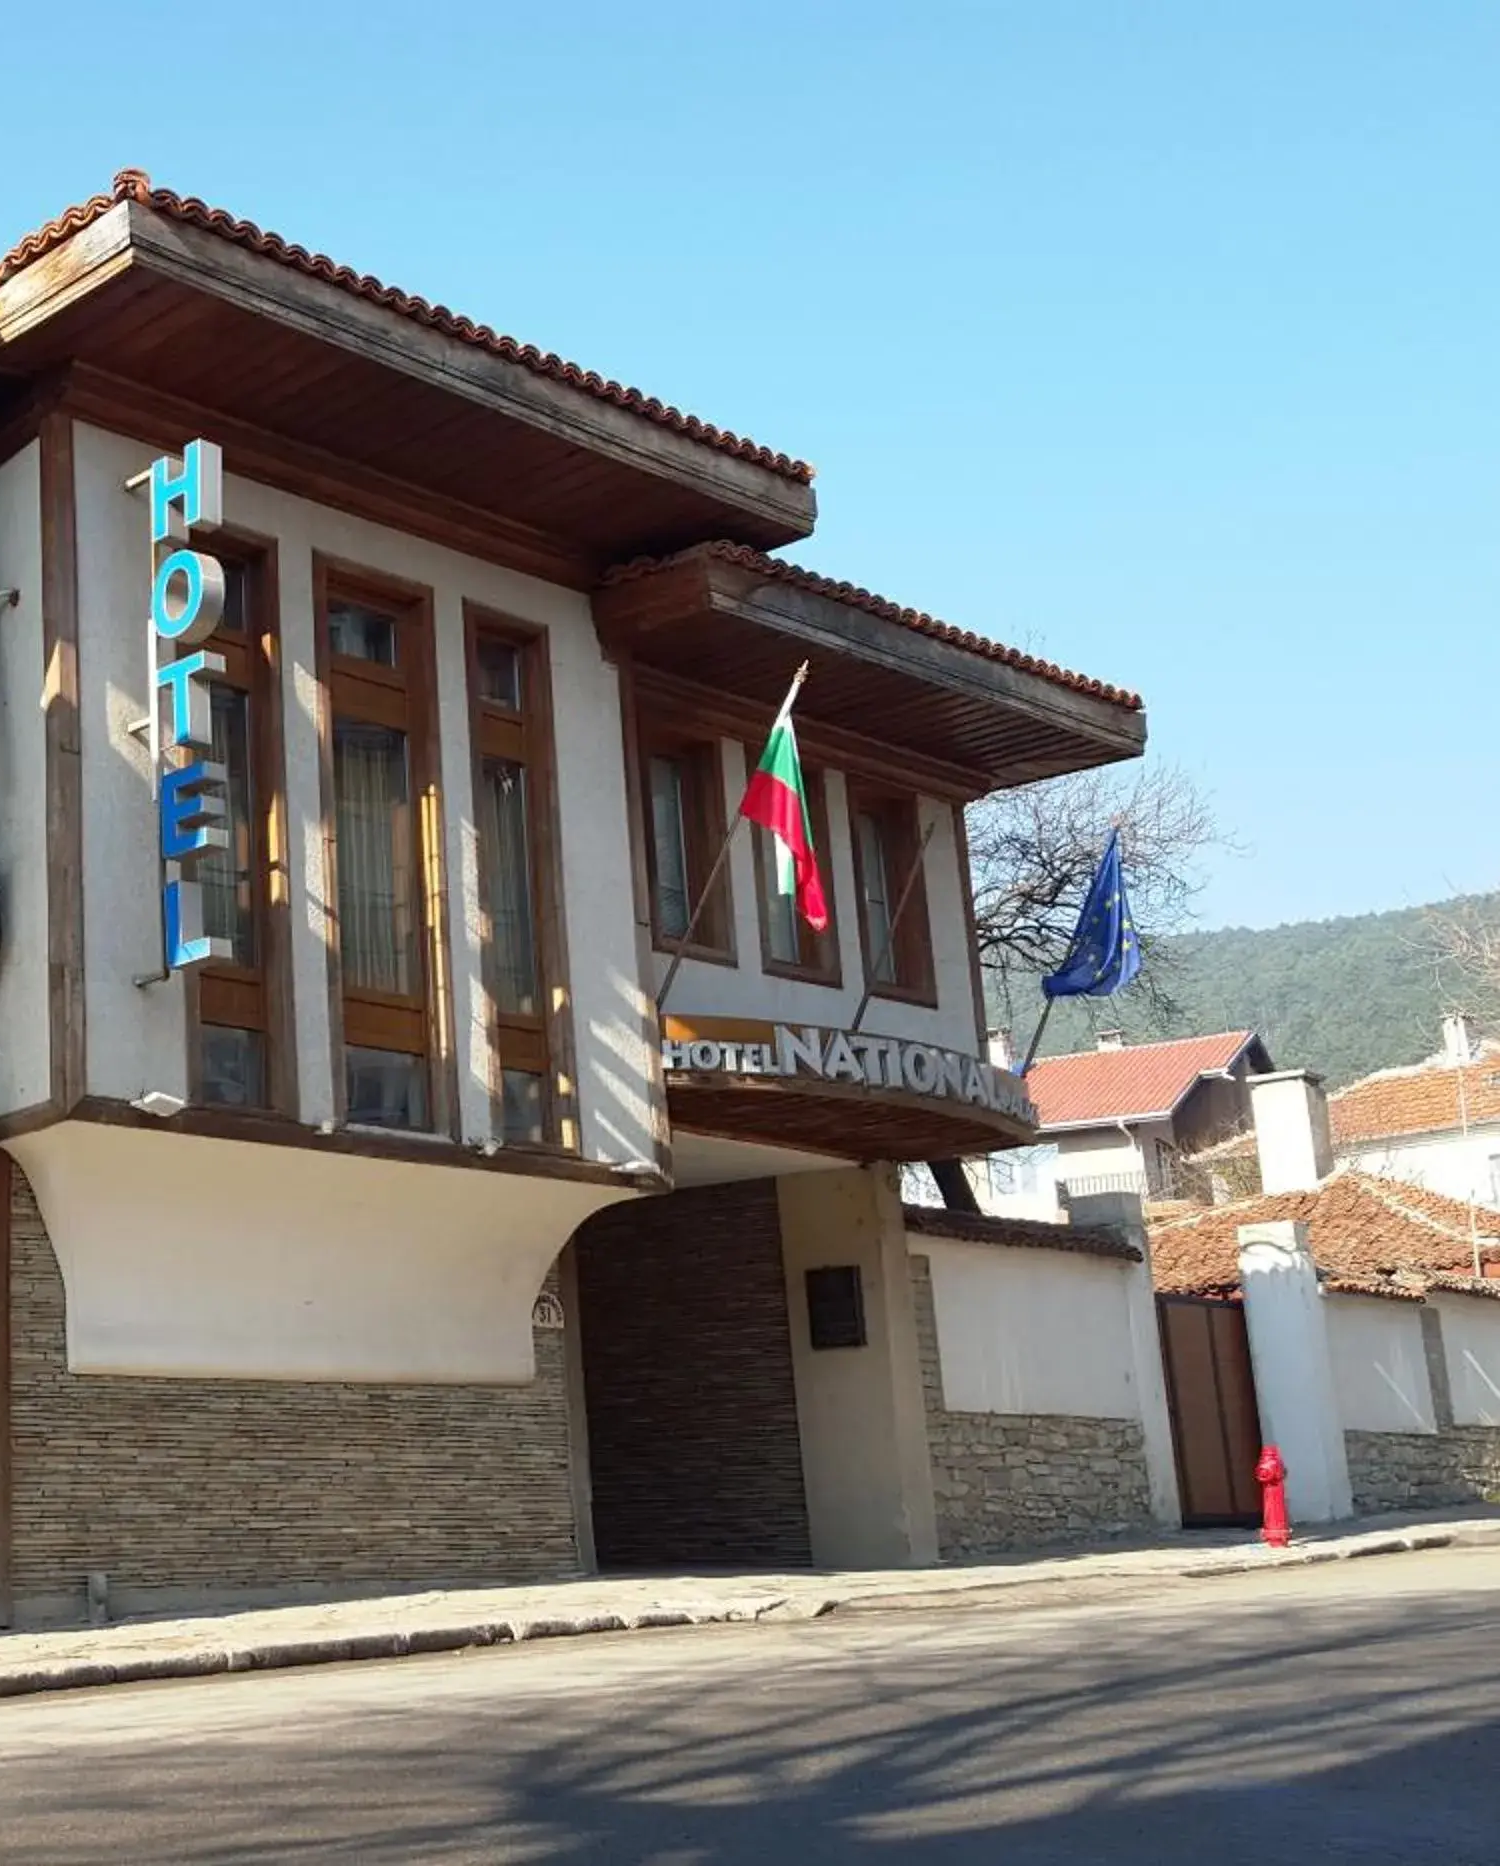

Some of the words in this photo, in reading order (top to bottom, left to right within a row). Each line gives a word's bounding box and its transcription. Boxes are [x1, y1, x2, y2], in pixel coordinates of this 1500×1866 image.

[150, 437, 216, 968] HOTEL
[661, 1039, 780, 1073] HOTEL
[773, 1023, 1001, 1112] NATIONAL
